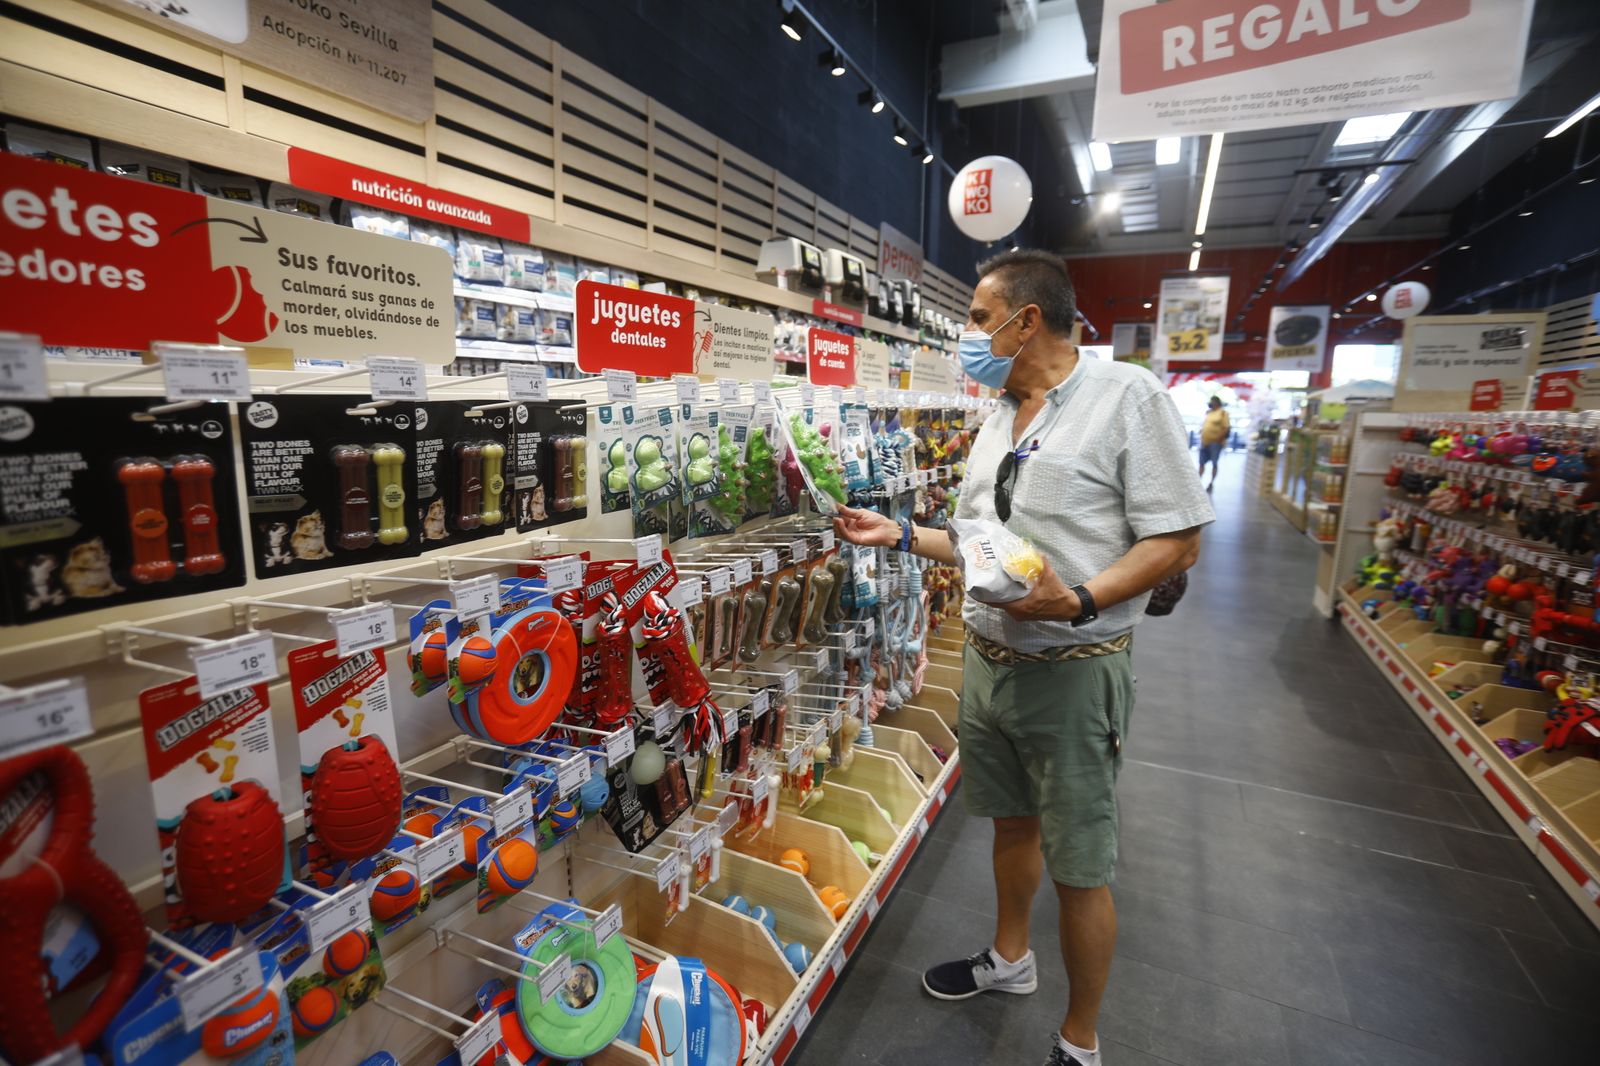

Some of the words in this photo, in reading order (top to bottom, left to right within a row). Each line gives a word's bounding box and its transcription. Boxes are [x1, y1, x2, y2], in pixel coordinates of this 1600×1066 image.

[339, 12, 399, 52] Sevilla
[263, 15, 341, 59] Adopción
[368, 60, 407, 86] 11.207
[1303, 81, 1349, 95] cachorro
[1352, 75, 1400, 88] mediano
[1188, 105, 1230, 116] mediano
[1240, 101, 1265, 110] maxi
[1267, 100, 1279, 108] de
[1370, 88, 1384, 96] un
[352, 178, 422, 208] nutrición
[426, 198, 492, 226] avanzada
[278, 247, 318, 271] Sus
[327, 255, 421, 287] favoritos.
[282, 278, 347, 298] Calmará
[352, 290, 374, 302] sus
[379, 294, 417, 308] ganas
[421, 297, 435, 310] de
[283, 301, 341, 320] morder,
[345, 307, 422, 326] olvidándose
[426, 316, 440, 328] de
[591, 290, 681, 328] juguetes
[284, 320, 308, 335] los
[314, 325, 377, 340] muebles.
[611, 328, 666, 348] dentales
[714, 322, 741, 336] Dientes
[743, 327, 770, 341] limpios.
[813, 334, 850, 356] juguetes
[1170, 333, 1206, 352] 3x2
[250, 441, 275, 449] TWO
[276, 440, 311, 448] BONES
[423, 444, 444, 453] BETTER
[425, 438, 444, 447] BONES
[33, 452, 82, 464] BONES
[275, 447, 315, 456] BETTER
[32, 461, 89, 474] BETTER
[252, 456, 281, 465] THAN
[282, 455, 304, 463] ONE
[253, 464, 280, 472] WITH
[281, 463, 303, 471] OUR
[1, 473, 41, 485] THAN
[44, 471, 74, 482] ONE
[254, 472, 280, 480] FULL
[255, 478, 301, 488] FLAVOUR
[2, 483, 40, 495] WITH
[42, 481, 73, 491] OUR
[255, 487, 280, 495] TWIN
[281, 485, 305, 493] PACK
[4, 493, 41, 504] FULL
[43, 491, 62, 501] OF
[5, 498, 71, 514] FLAVOUR
[623, 560, 672, 608] DOGZILLA
[368, 623, 382, 635] 18
[241, 656, 259, 670] 18
[303, 649, 375, 704] DOGZILLA
[37, 711, 64, 728] 16
[158, 687, 254, 749] DOGZILLA
[448, 847, 454, 857] 5
[232, 972, 242, 986] 3
[691, 971, 703, 1006] Chuckit!
